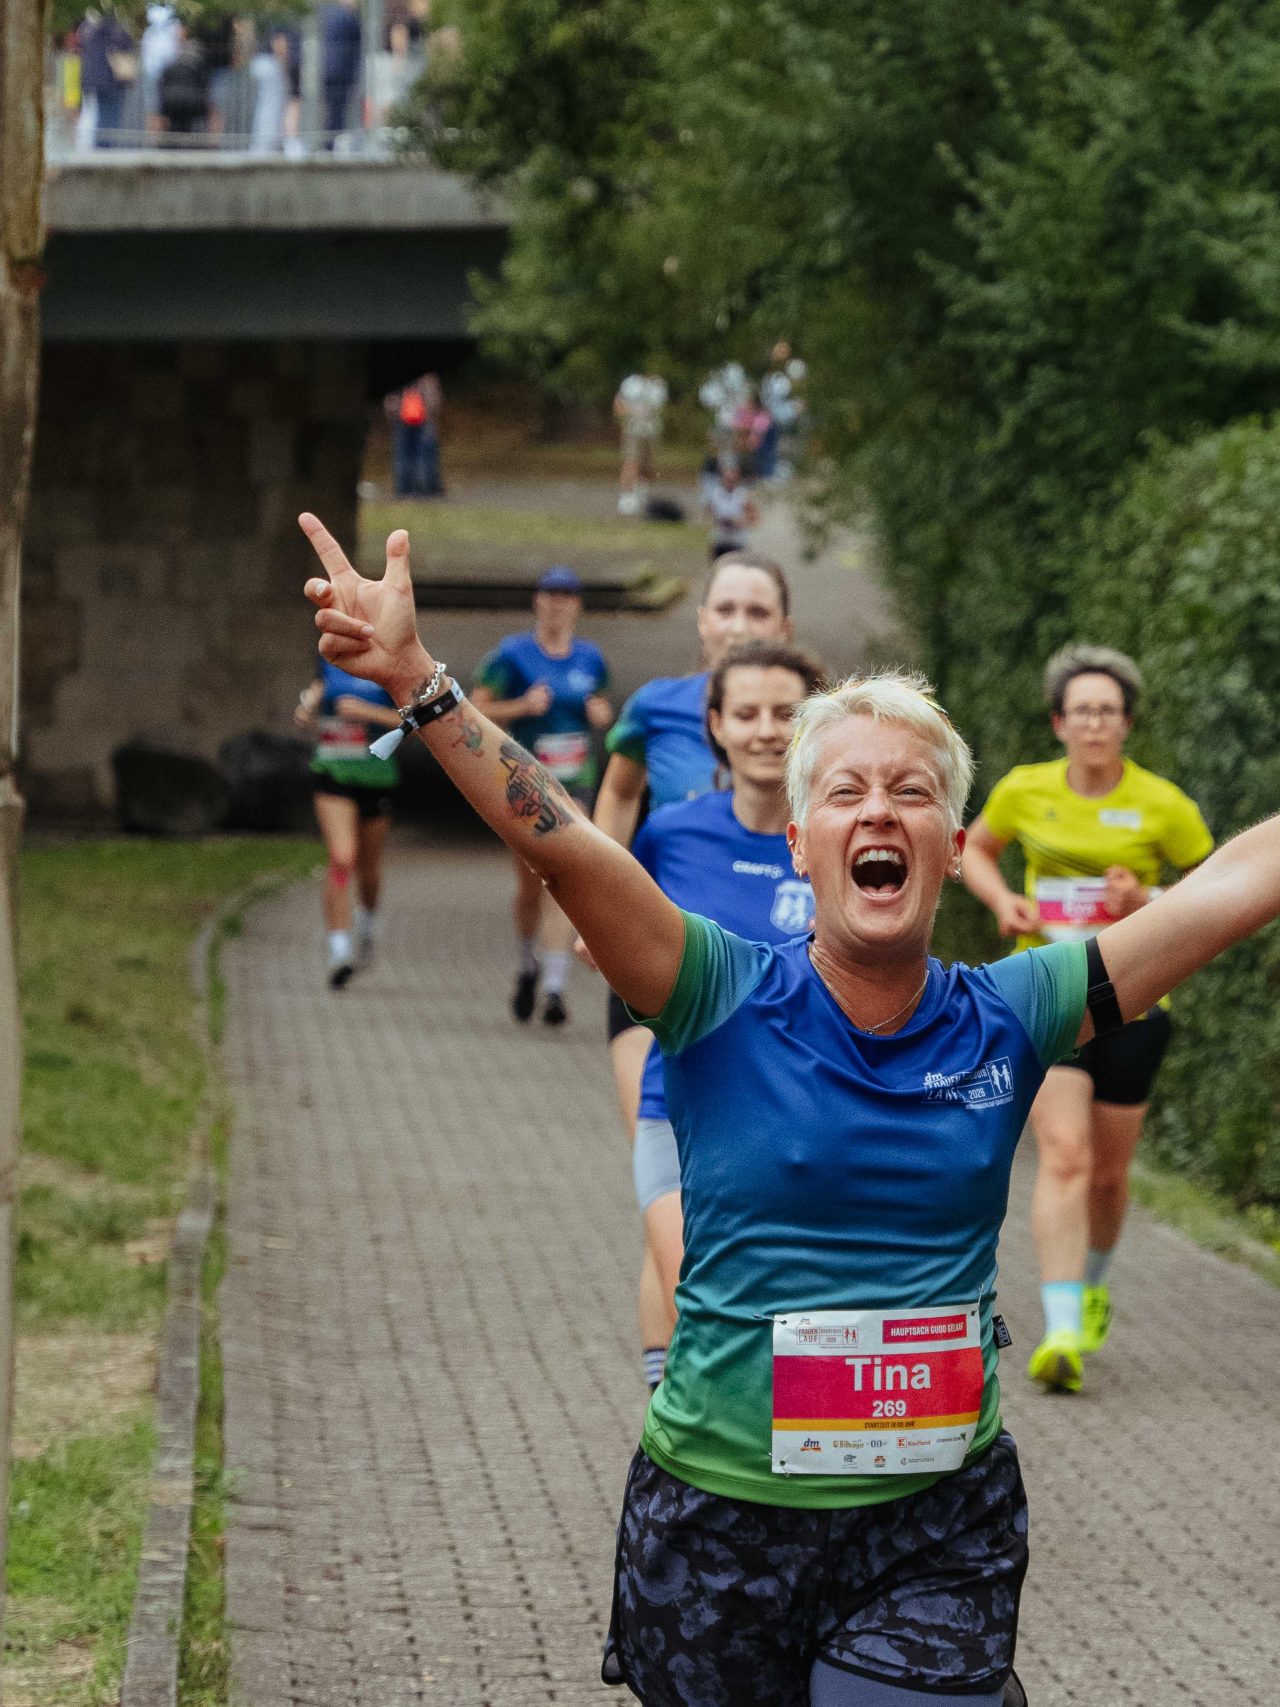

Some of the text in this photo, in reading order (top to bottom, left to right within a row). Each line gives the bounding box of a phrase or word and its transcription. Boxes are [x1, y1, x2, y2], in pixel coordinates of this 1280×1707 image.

[890, 1325, 929, 1337] HAUPTSACH
[798, 1335, 818, 1343] LAUF
[845, 1358, 931, 1391] Tina
[872, 1399, 907, 1418] 269
[864, 1421, 890, 1429] STARTZEIT
[803, 1438, 821, 1448] dm
